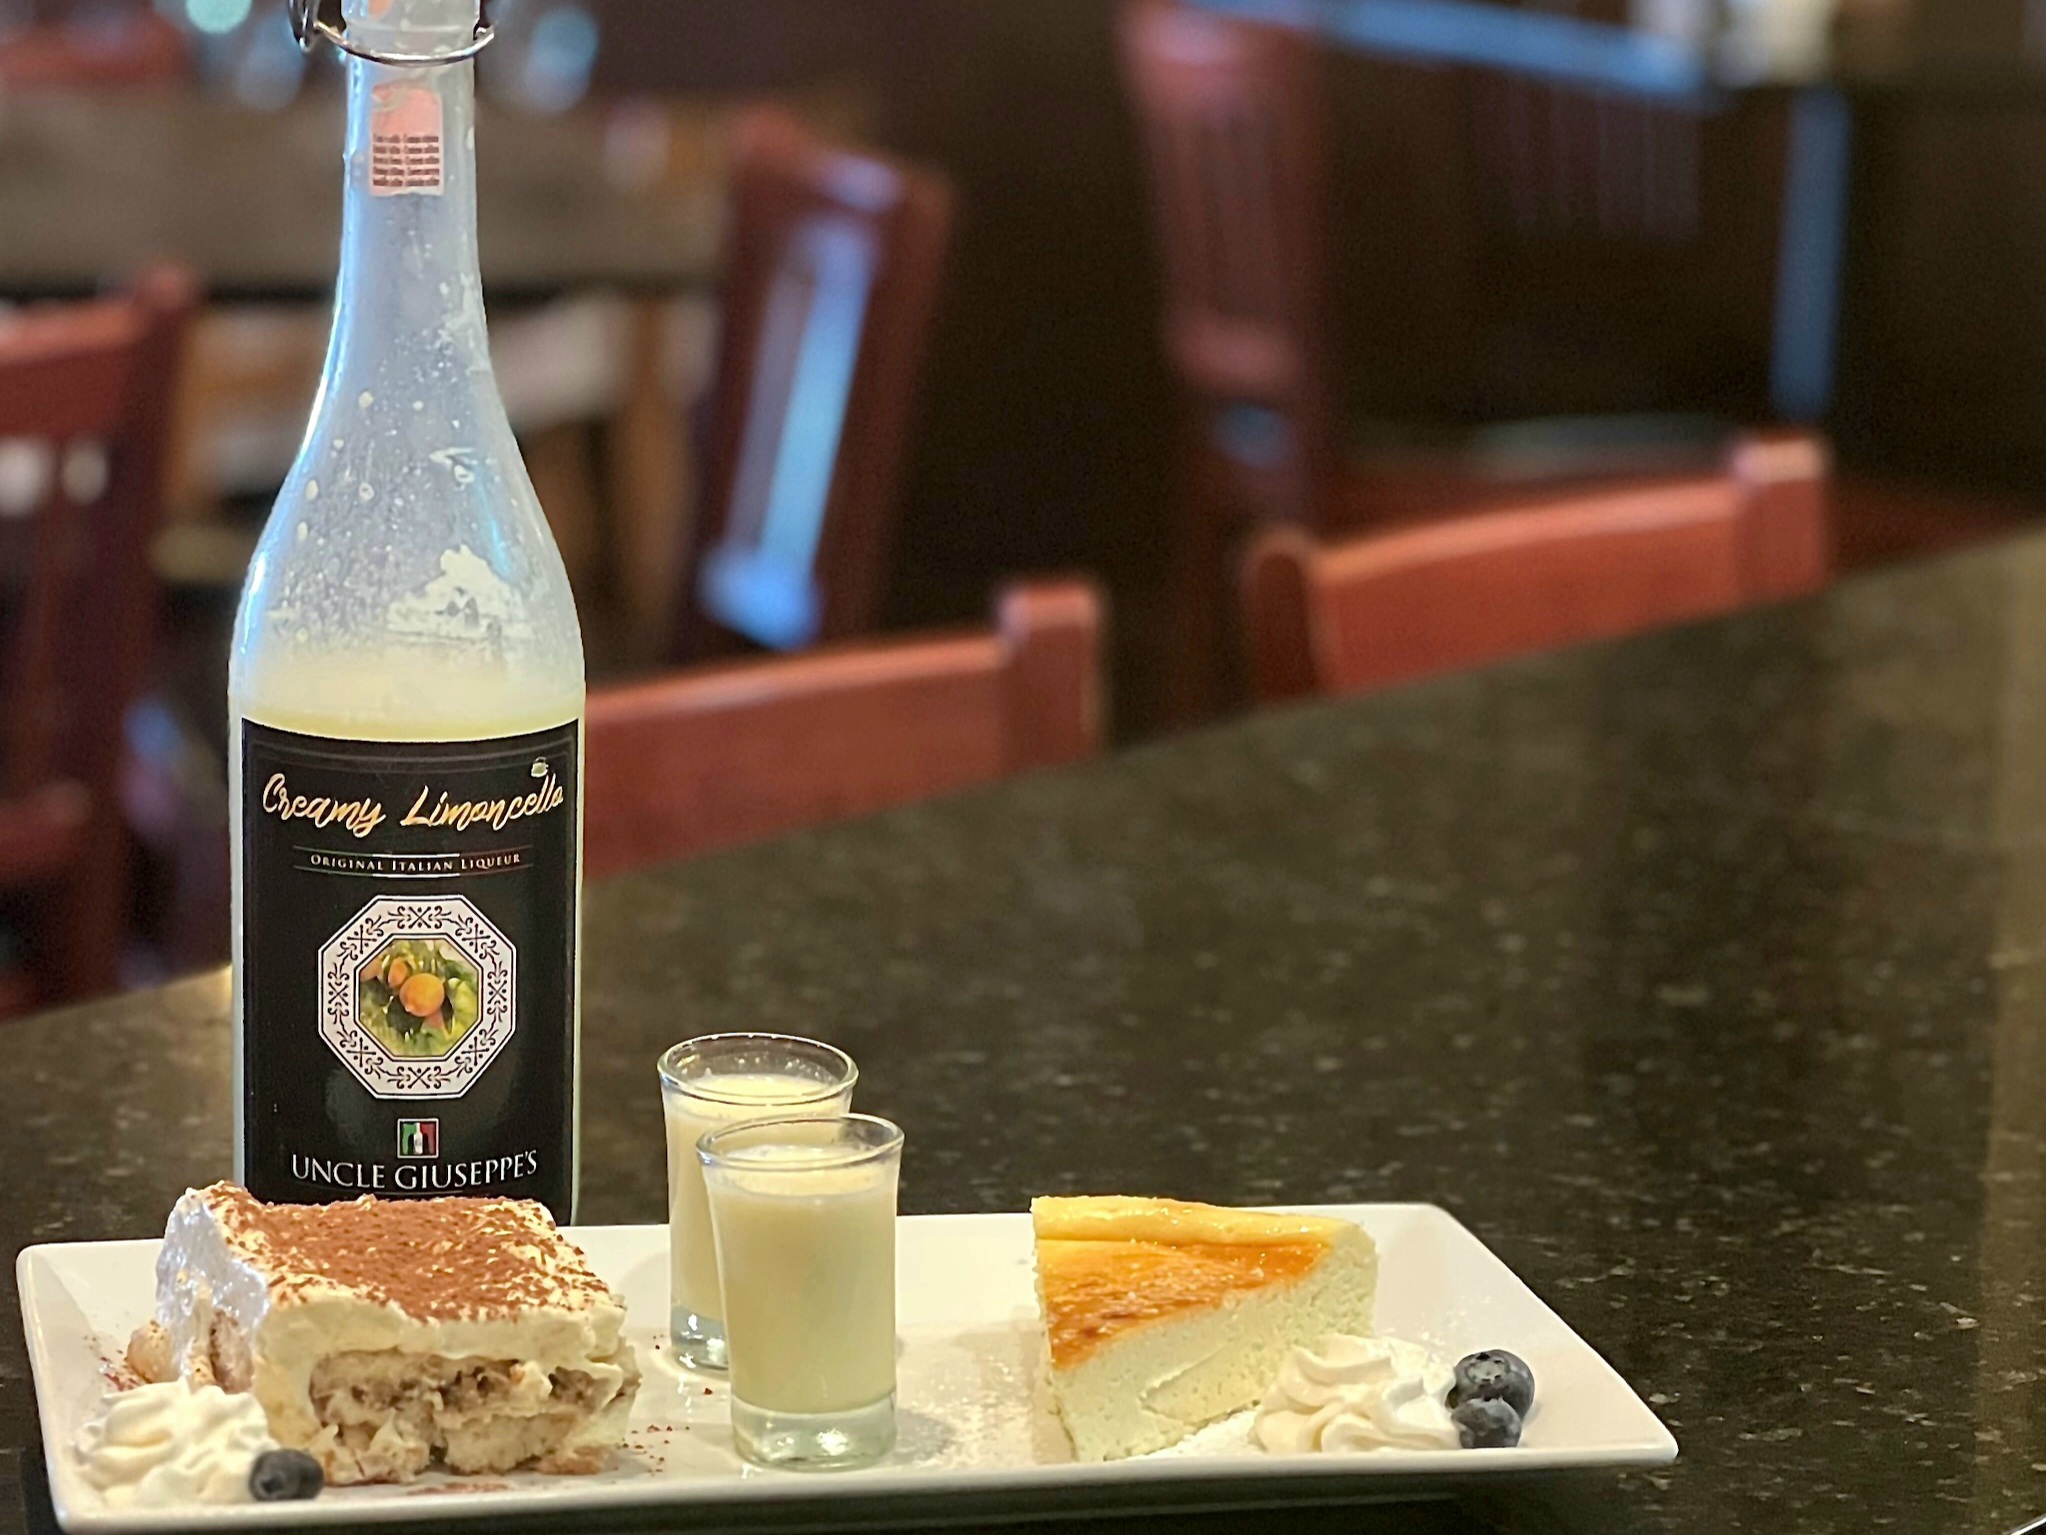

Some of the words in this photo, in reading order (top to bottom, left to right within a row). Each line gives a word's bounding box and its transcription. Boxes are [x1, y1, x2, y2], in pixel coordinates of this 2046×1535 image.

[263, 773, 386, 837] Creamy
[400, 774, 564, 831] Limoncello
[310, 854, 384, 871] ORIGINAL
[392, 859, 453, 872] ITALIAN
[460, 853, 521, 870] LIQUEUR
[292, 1154, 385, 1188] UNCLE
[394, 1150, 538, 1189] GIUSEPPE'S
